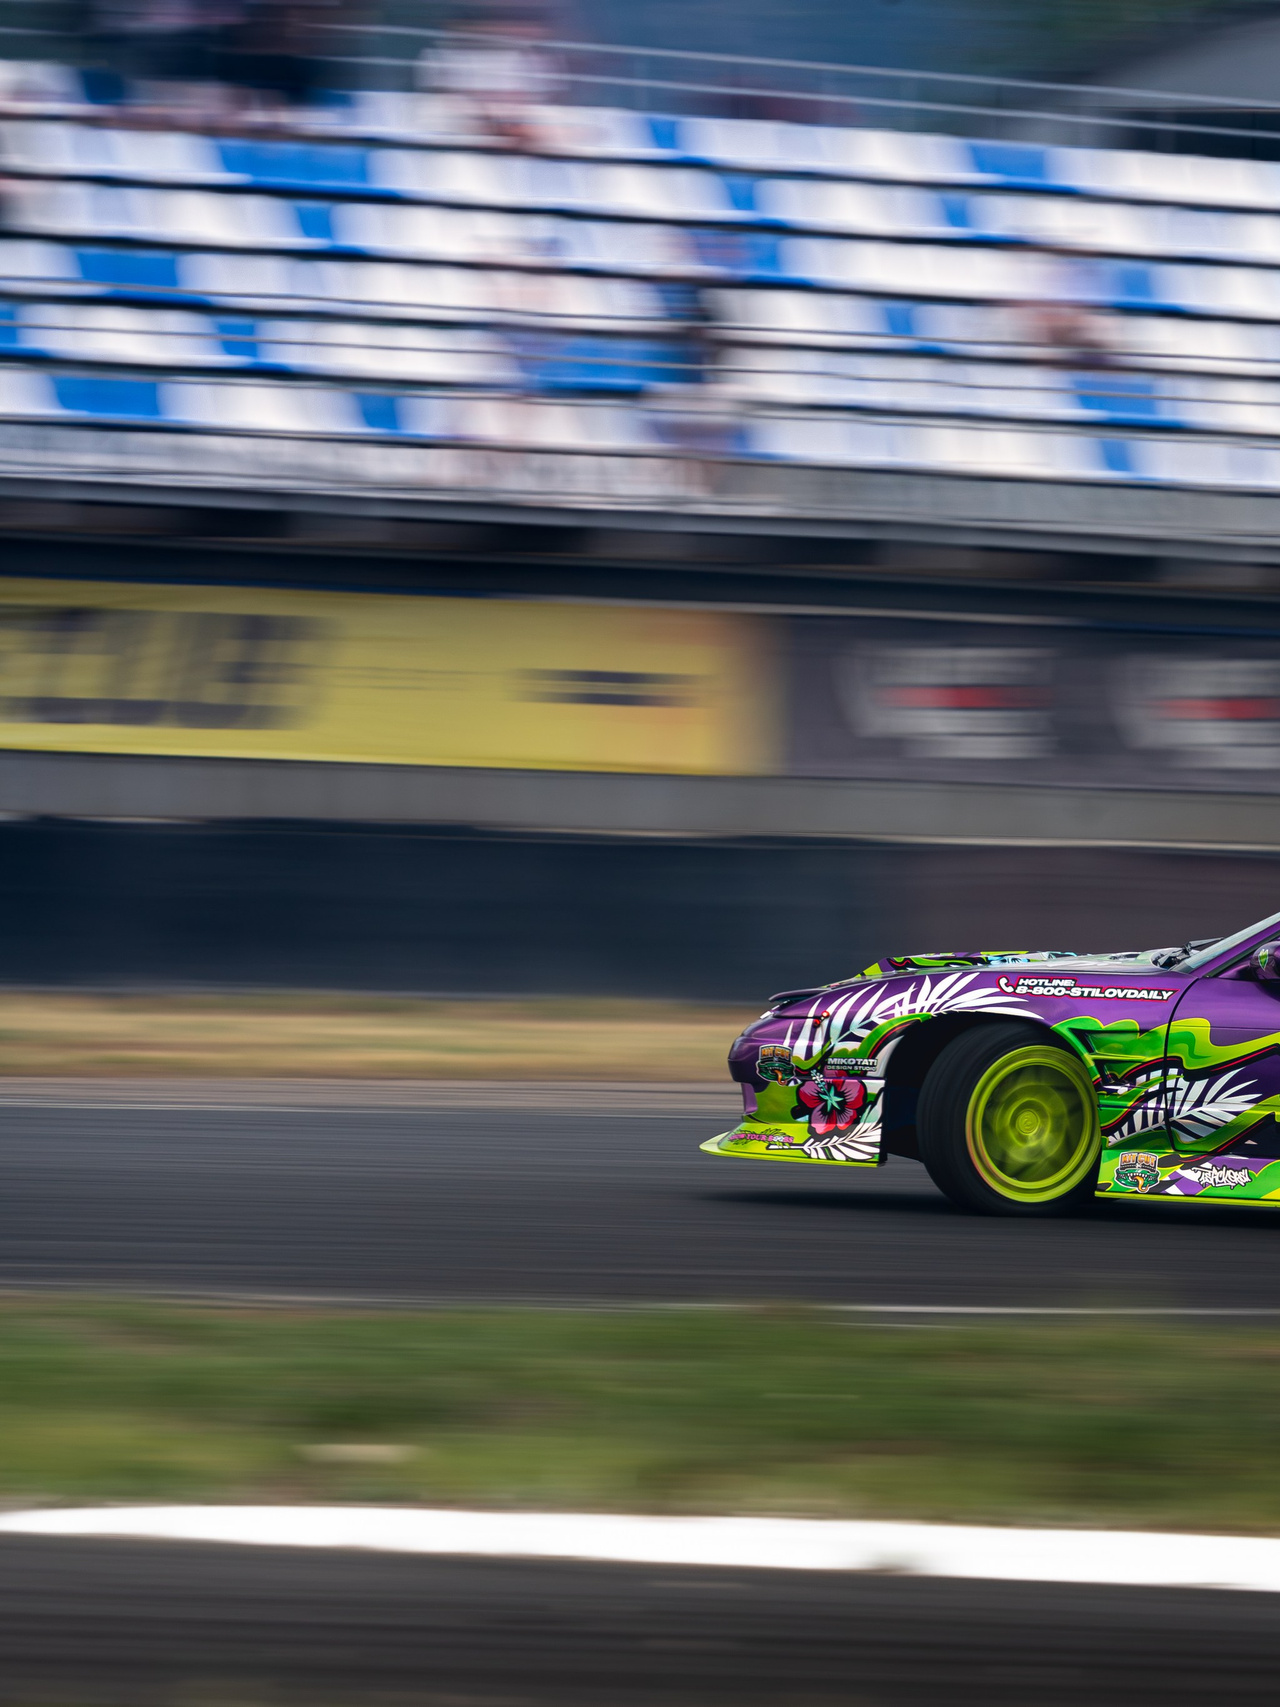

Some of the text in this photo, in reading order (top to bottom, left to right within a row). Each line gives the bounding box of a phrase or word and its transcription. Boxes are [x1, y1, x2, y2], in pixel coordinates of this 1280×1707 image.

[1018, 978, 1076, 987] HOTLINE:
[1015, 986, 1174, 1000] 8-800-STILOVDAILY
[1121, 1153, 1156, 1167] KIT CUT
